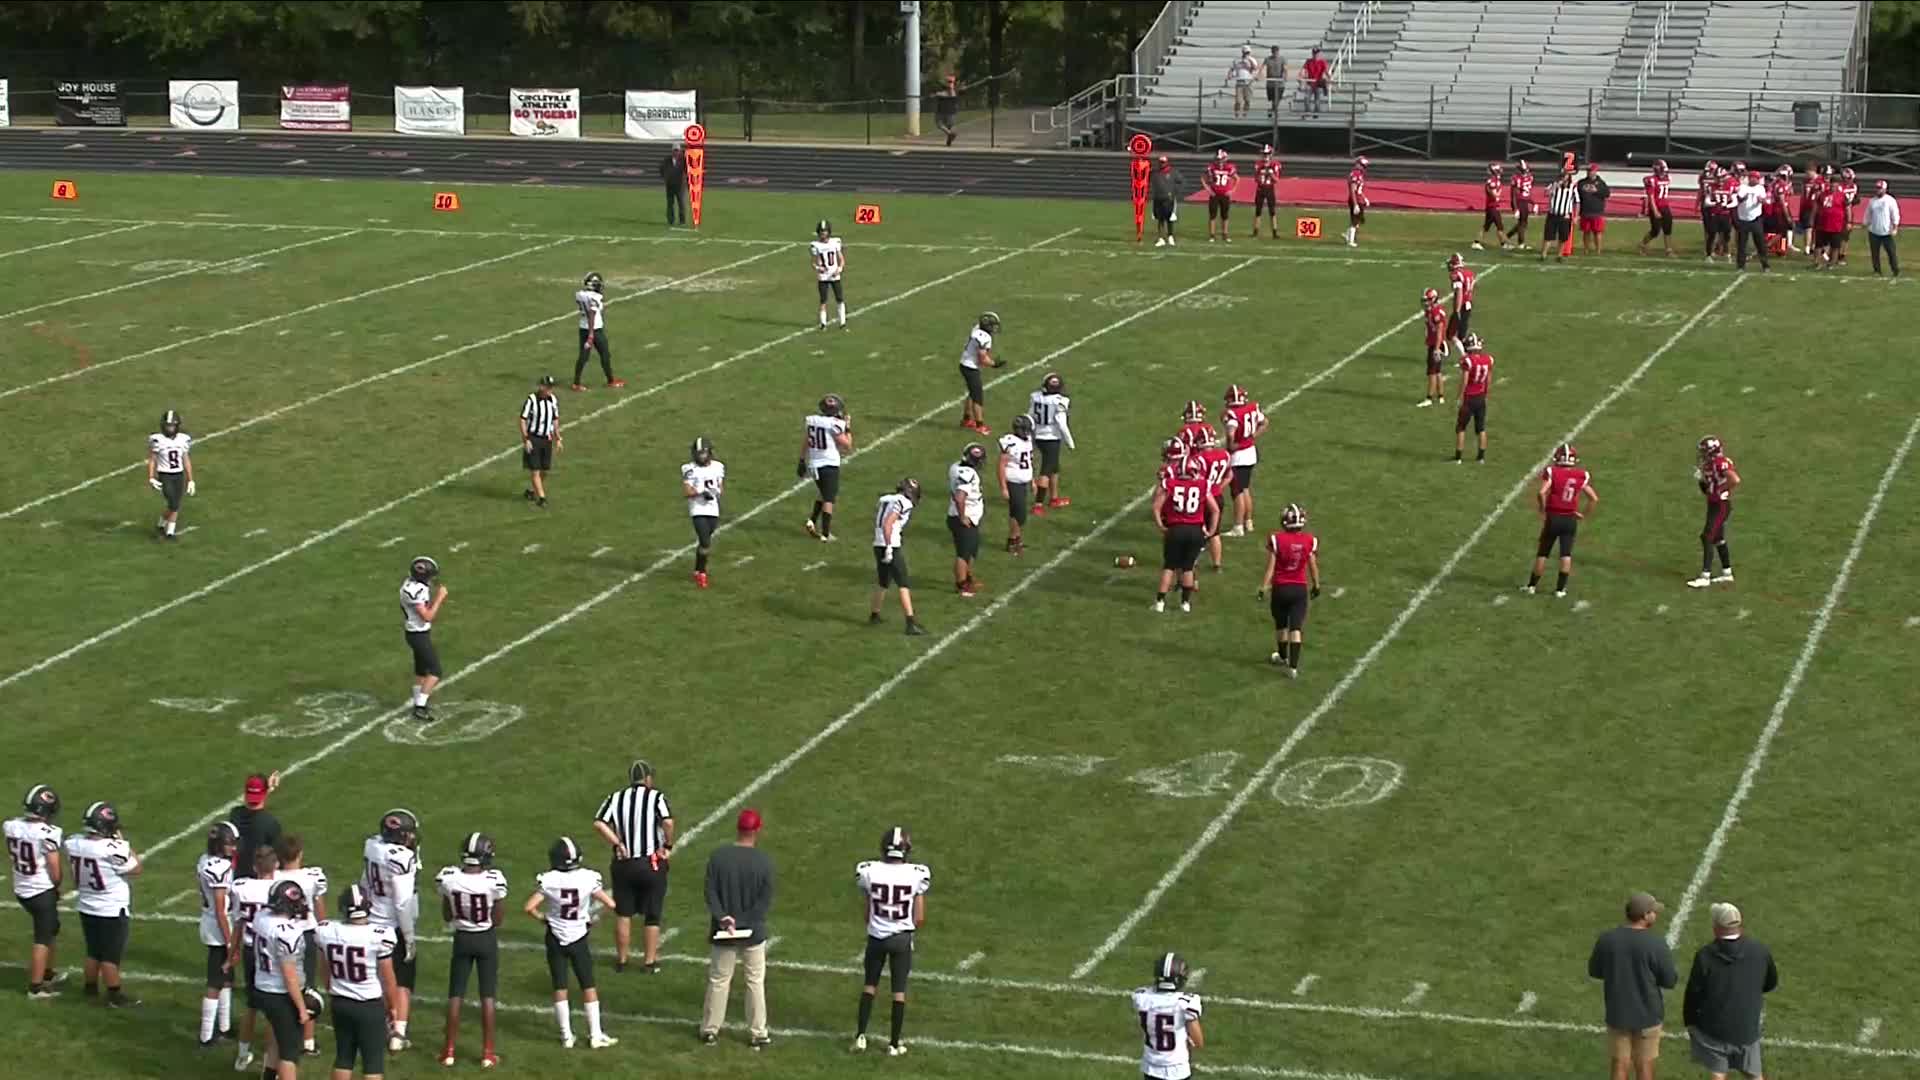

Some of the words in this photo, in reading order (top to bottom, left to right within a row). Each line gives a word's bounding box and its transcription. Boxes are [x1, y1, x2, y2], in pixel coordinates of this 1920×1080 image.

[58, 82, 79, 92] JOY
[82, 83, 117, 93] HOUSE
[514, 109, 530, 118] GO
[533, 110, 577, 119] TIGERS!
[1564, 152, 1575, 170] 2
[436, 195, 452, 208] 10
[859, 208, 875, 222] 20
[1300, 221, 1317, 235] 30
[819, 250, 835, 271] 10
[1034, 402, 1049, 425] 51
[1209, 459, 1228, 485] 67
[1173, 486, 1200, 514] 58
[1562, 478, 1577, 502] 6
[1121, 750, 1402, 809] 40
[7, 837, 37, 877] 59
[69, 855, 107, 891] 73
[452, 891, 488, 922] 18
[559, 888, 579, 920] 2
[870, 882, 912, 919] 25
[326, 943, 368, 983] 66
[1139, 1011, 1176, 1052] 16
